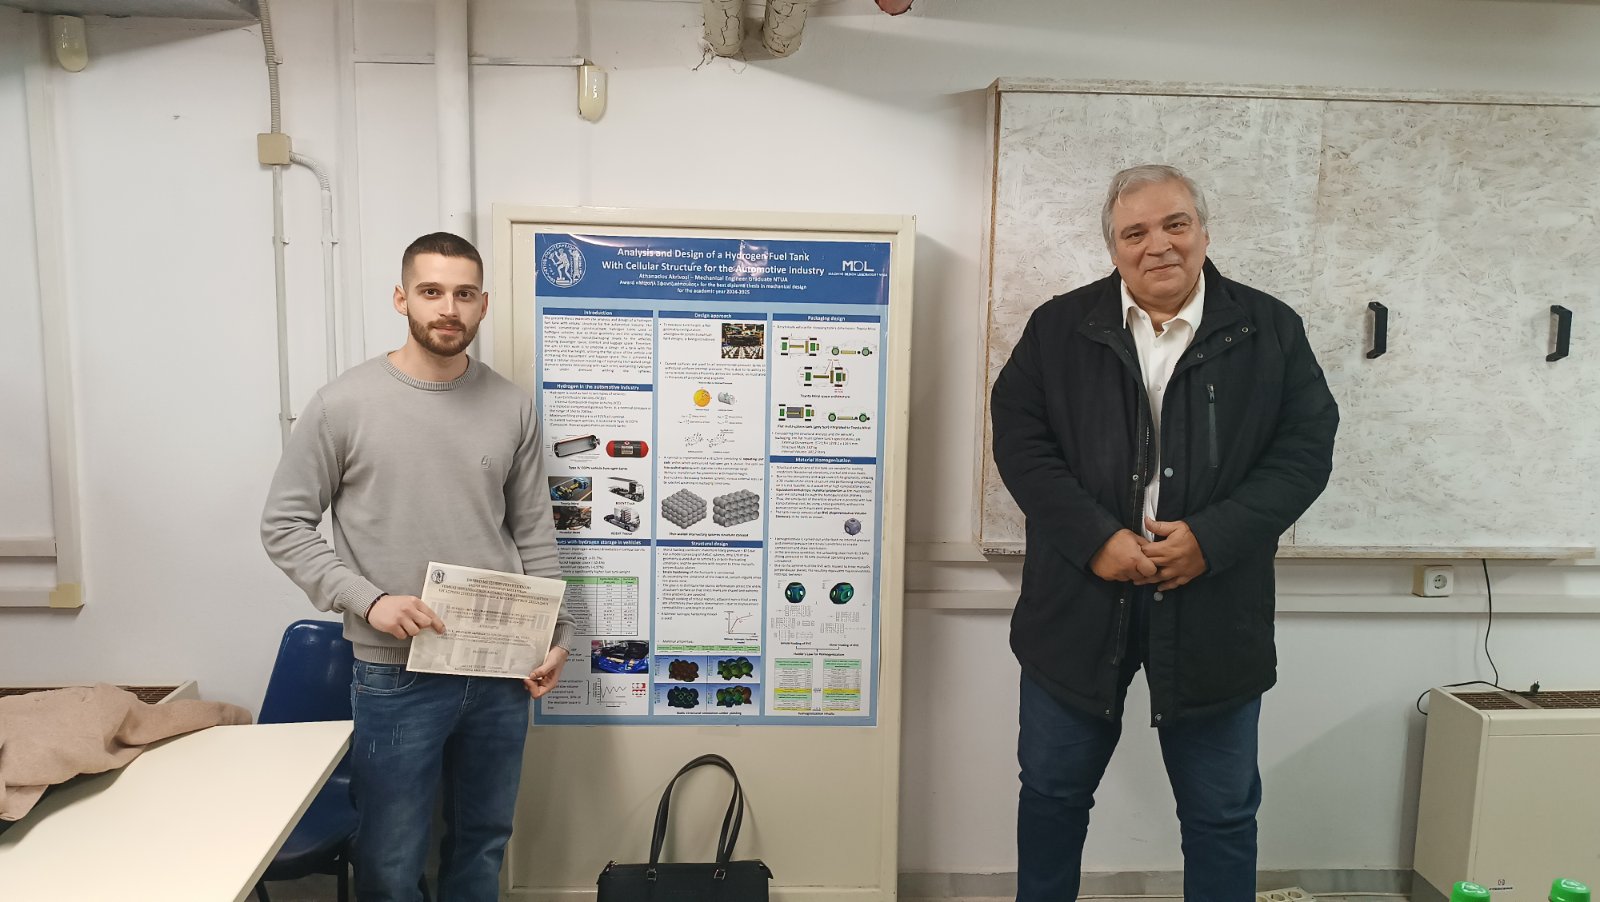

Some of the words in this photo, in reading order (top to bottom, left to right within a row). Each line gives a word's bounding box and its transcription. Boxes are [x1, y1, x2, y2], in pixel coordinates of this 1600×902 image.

[617, 248, 653, 258] Analysis
[653, 250, 672, 258] and
[674, 249, 704, 260] Design
[706, 250, 716, 259] of
[725, 251, 768, 263] Hydrogen
[769, 252, 787, 261] Fuel
[790, 252, 810, 262] Tank
[601, 260, 623, 270] With
[625, 260, 659, 271] Cellular
[661, 261, 702, 272] Structure
[704, 262, 716, 272] for
[719, 264, 733, 273] the
[735, 264, 787, 275] Automotive
[789, 265, 825, 276] Industry
